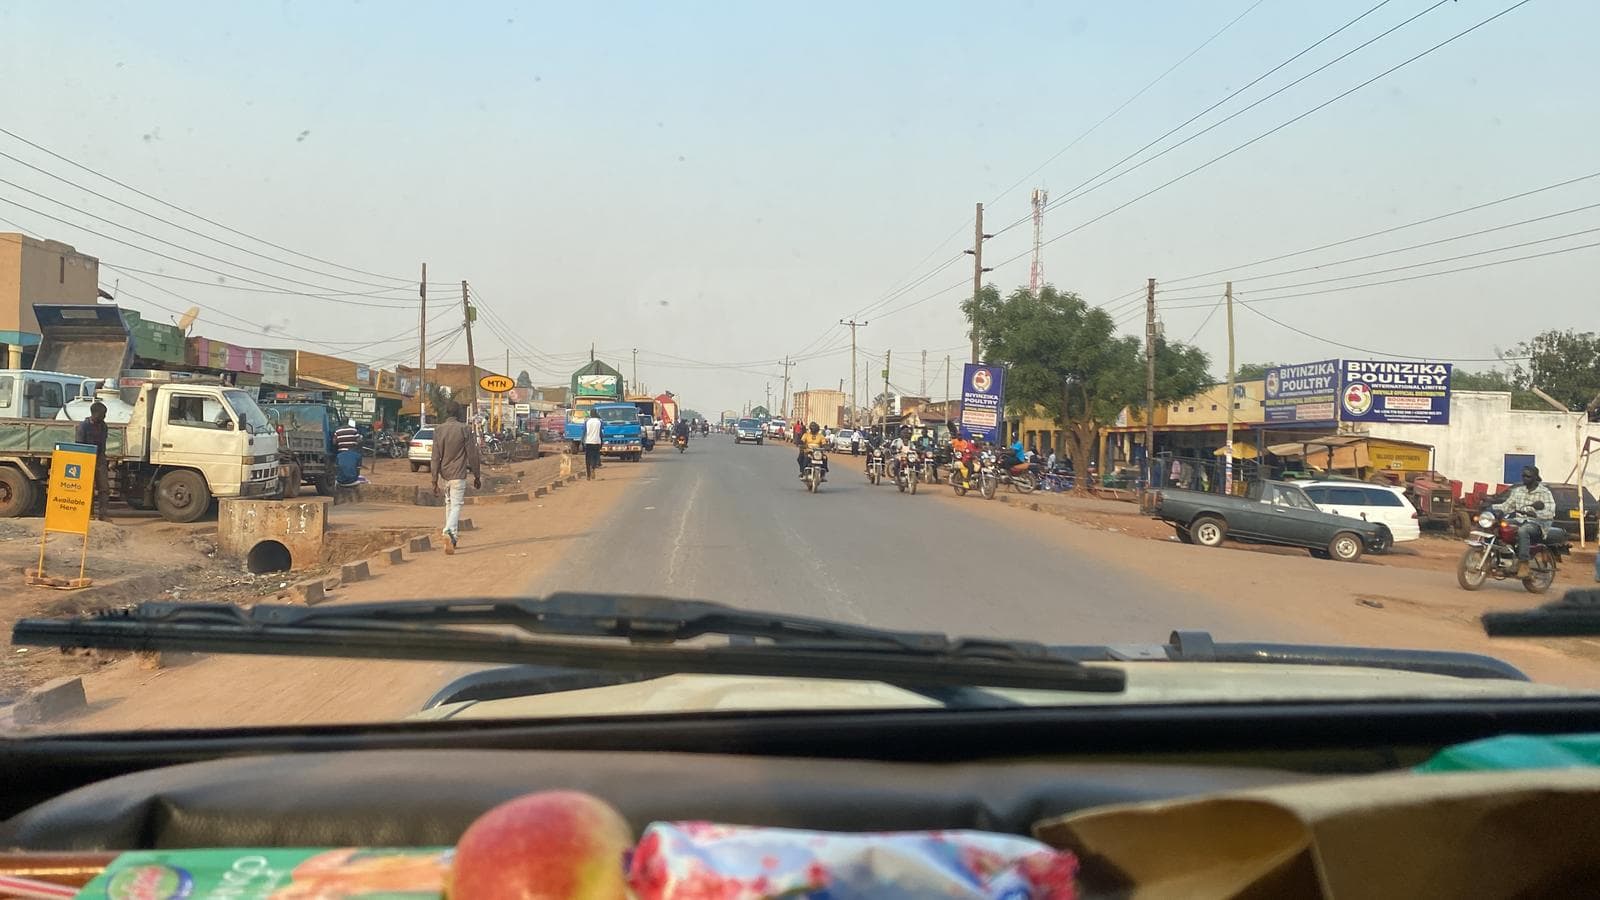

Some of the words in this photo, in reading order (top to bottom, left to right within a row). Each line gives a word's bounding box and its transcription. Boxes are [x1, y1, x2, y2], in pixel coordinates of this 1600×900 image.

[1280, 363, 1335, 379] BIYINZIKA
[1348, 362, 1447, 374] BIYINZIKA
[487, 380, 506, 388] MTN
[1282, 377, 1332, 391] POULTRY
[1348, 373, 1447, 384] POULTRY
[53, 496, 86, 506] Available
